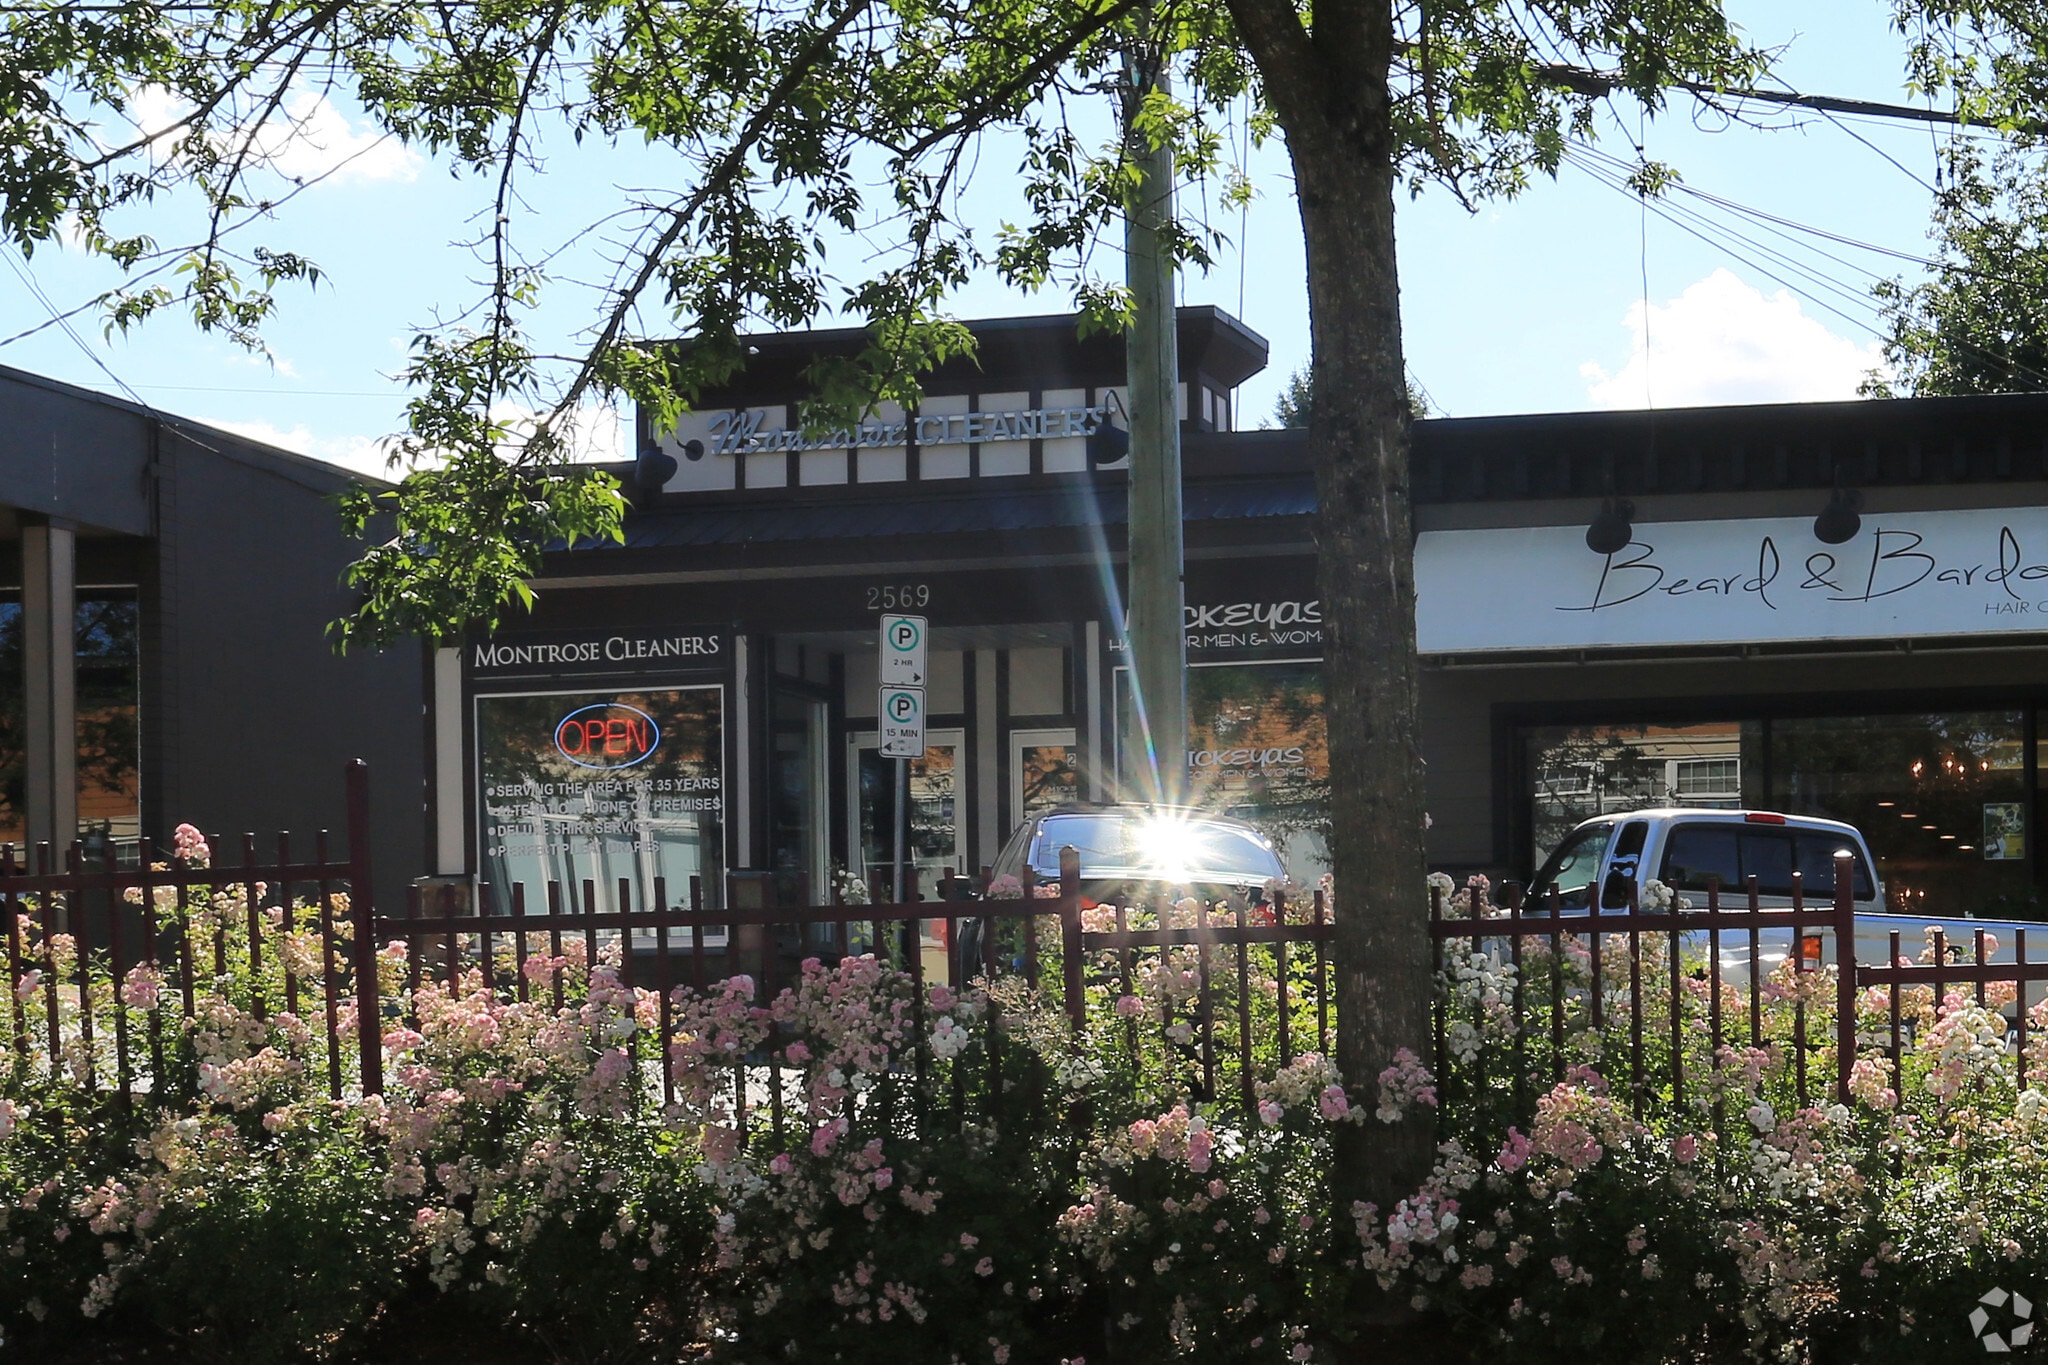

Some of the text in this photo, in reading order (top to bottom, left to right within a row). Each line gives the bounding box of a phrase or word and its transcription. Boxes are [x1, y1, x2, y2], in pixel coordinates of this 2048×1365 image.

[1555, 536, 1779, 612] Beard
[1800, 553, 1843, 592] &
[867, 585, 930, 610] 2569
[1985, 601, 2030, 615] HAIR
[898, 627, 912, 645] P
[1204, 634, 1246, 647] MEN
[1249, 632, 1268, 646] &
[1270, 630, 1323, 645] WOM
[474, 635, 720, 667] MONTROSE CLEANERS
[893, 658, 913, 667] 2 HR
[897, 699, 910, 717] P
[559, 718, 648, 755] OPEN
[886, 728, 918, 738] 15 MIN
[1216, 769, 1246, 779] MEN
[1262, 766, 1315, 779] WOMEN
[496, 778, 720, 798] SERVING THE AREA FOR 35 YEARS
[653, 798, 721, 812] PREMISES
[497, 823, 549, 837] DELUE
